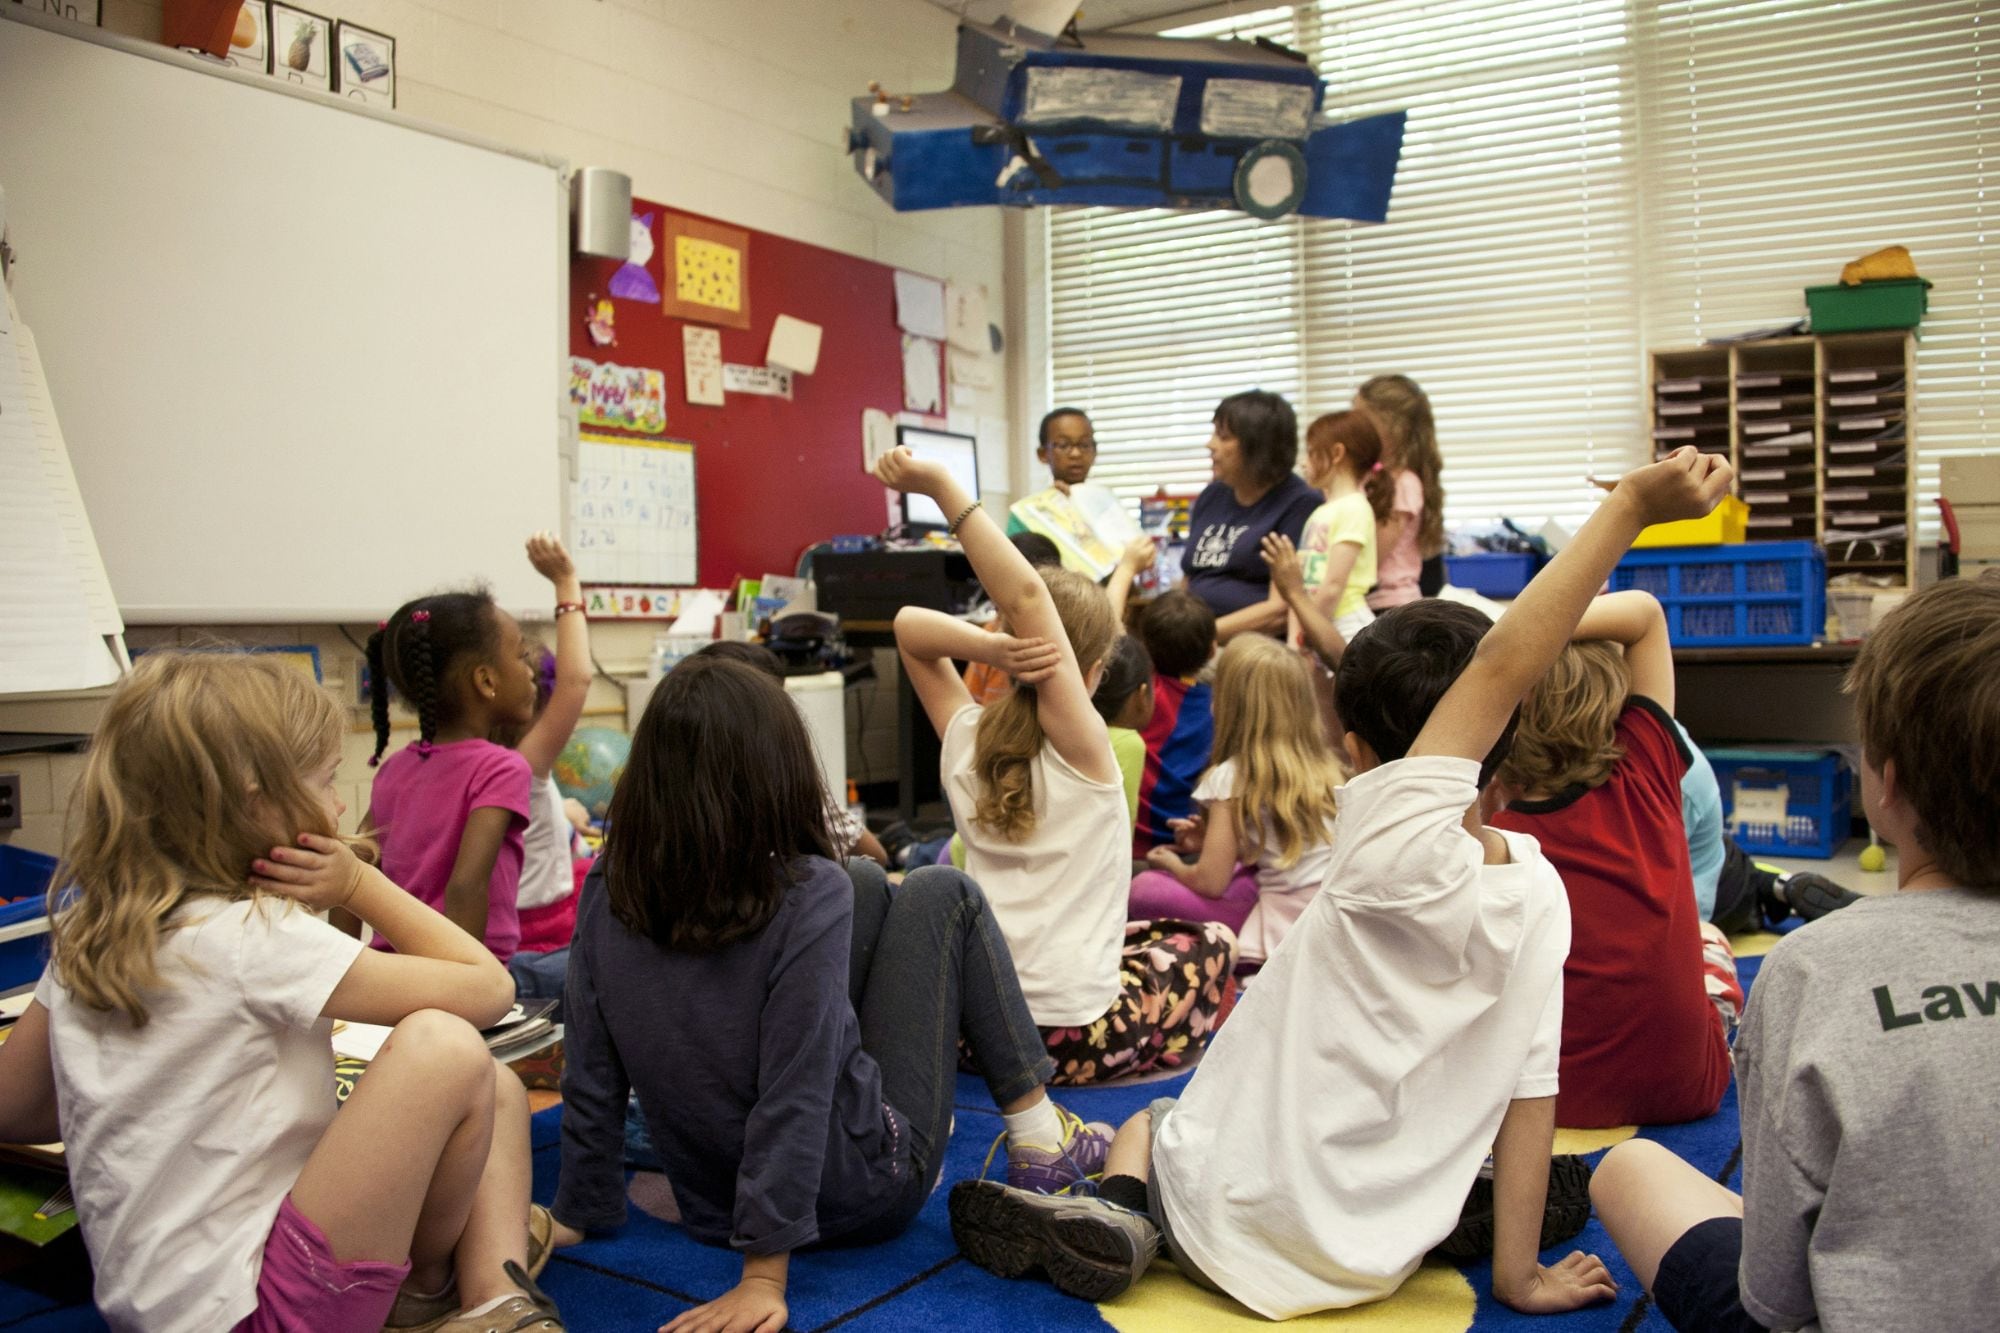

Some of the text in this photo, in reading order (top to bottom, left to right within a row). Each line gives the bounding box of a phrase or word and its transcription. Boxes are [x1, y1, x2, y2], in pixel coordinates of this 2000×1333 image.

[590, 594, 668, 612] A B C
